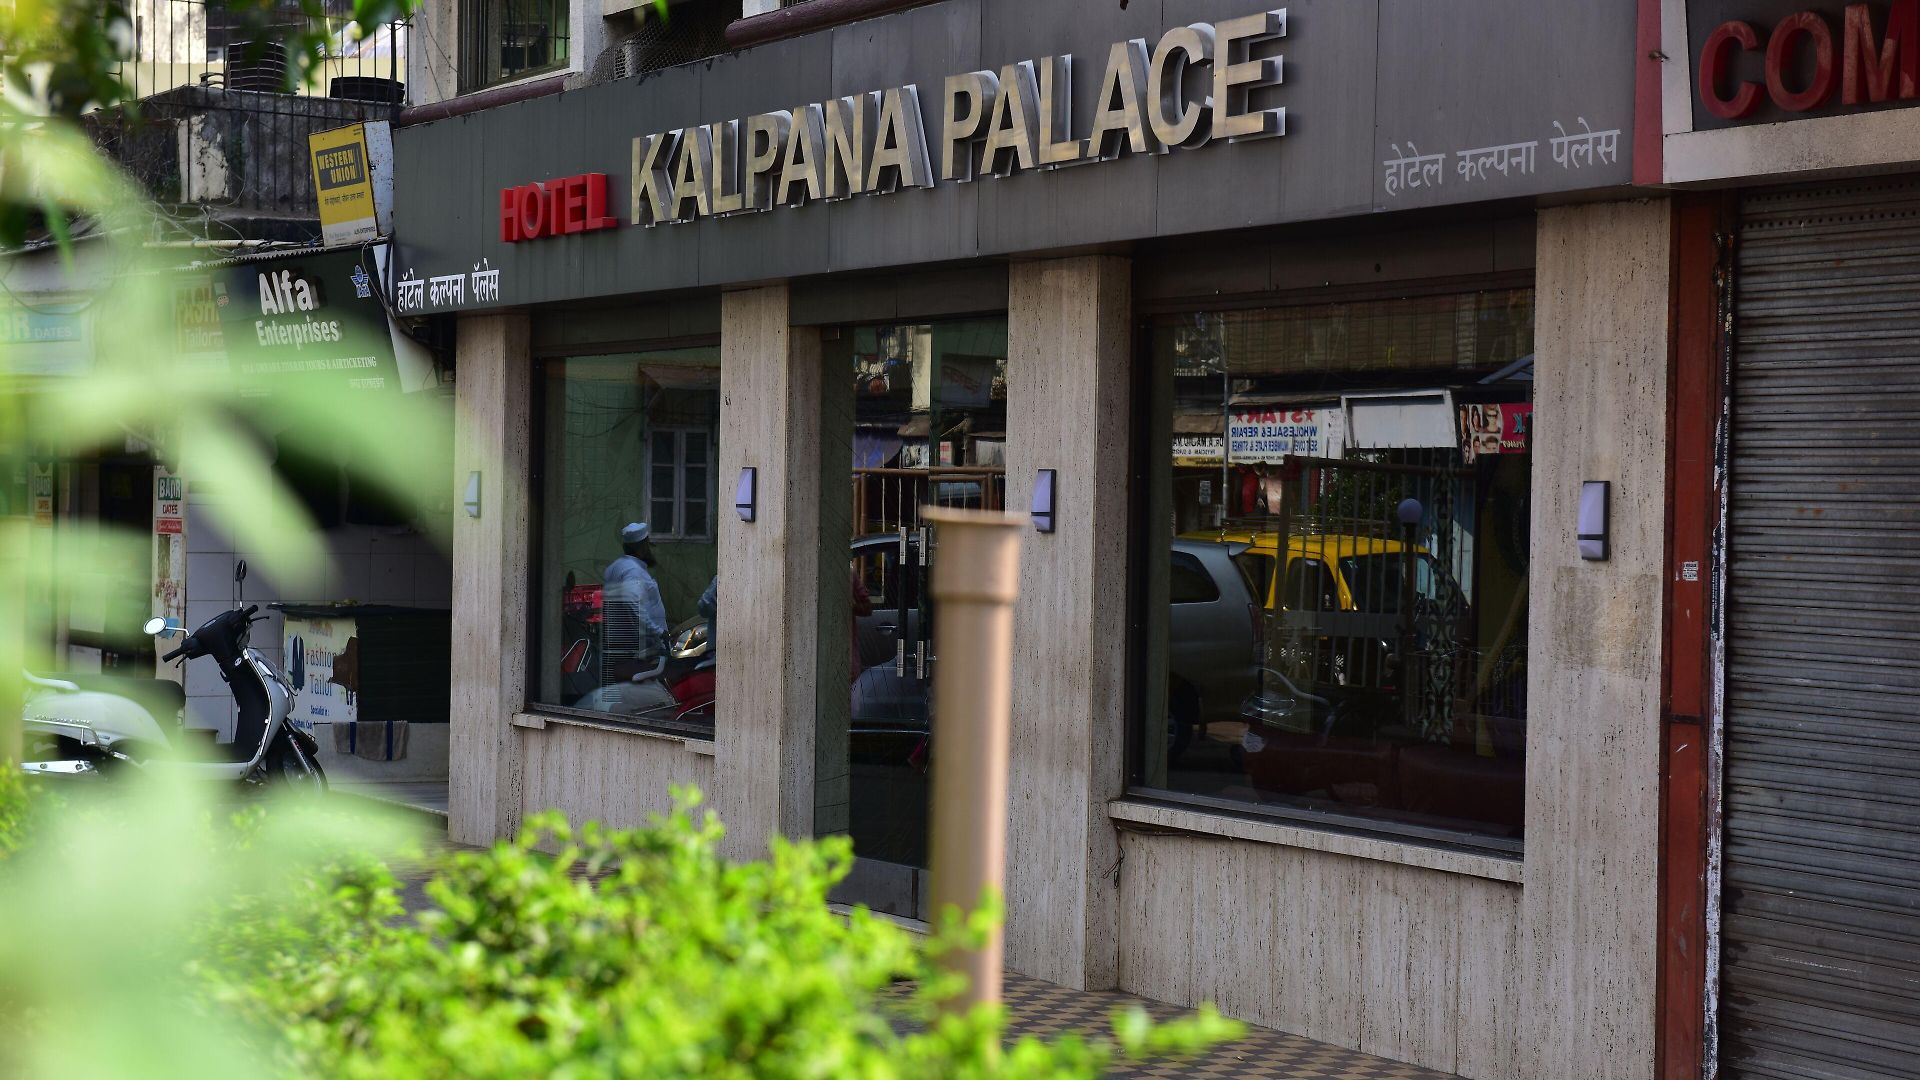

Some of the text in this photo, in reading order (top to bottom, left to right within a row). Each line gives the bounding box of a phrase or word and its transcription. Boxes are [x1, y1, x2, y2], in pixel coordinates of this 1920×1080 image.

[501, 8, 1287, 243] HOTEL KALPANA PALACE
[317, 149, 354, 170] WESTERN
[1384, 116, 1620, 196] होटेल कल्पना पेलेस
[331, 165, 356, 184] UNION
[259, 269, 313, 316] Alfa
[430, 273, 465, 307] कल्पना
[34, 326, 73, 339] DATES
[184, 326, 211, 347] Tailor
[255, 315, 340, 351] Enterprises
[332, 356, 377, 369] AIRTICKETING
[160, 478, 181, 498] BADR
[163, 504, 178, 514] DATES
